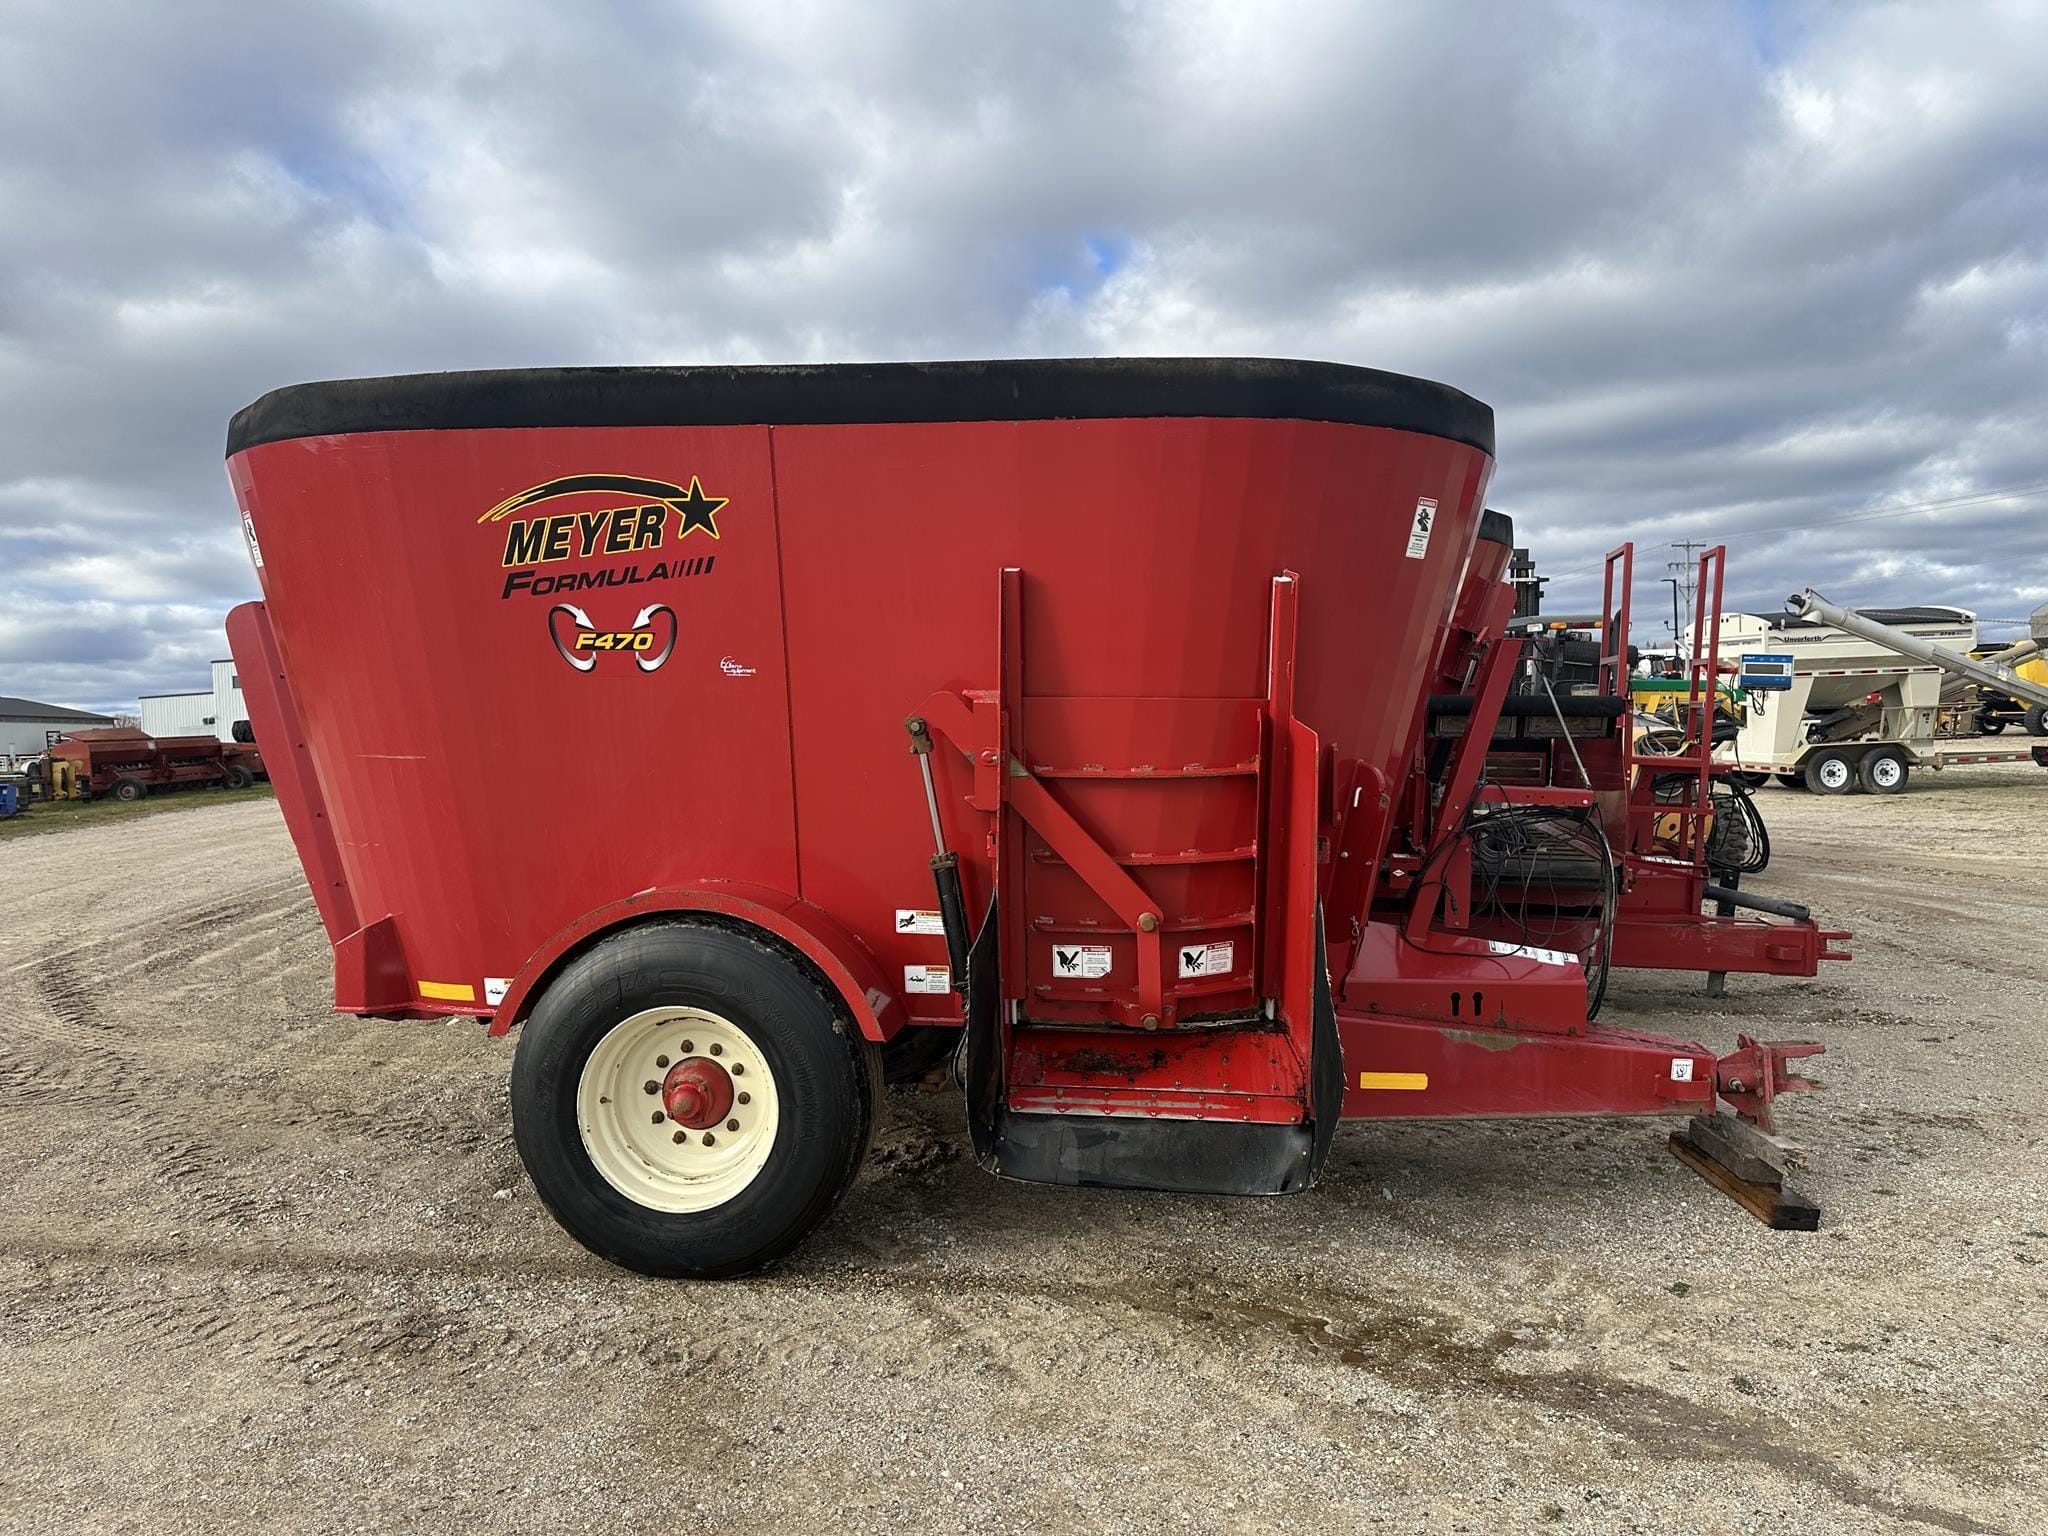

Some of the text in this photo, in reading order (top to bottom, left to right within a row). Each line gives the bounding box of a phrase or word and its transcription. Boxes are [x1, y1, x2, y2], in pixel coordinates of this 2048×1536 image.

[502, 504, 668, 567] MEYER
[502, 561, 669, 599] FORMULA
[575, 632, 655, 651] F470
[1784, 635, 1823, 643] Unverforth
